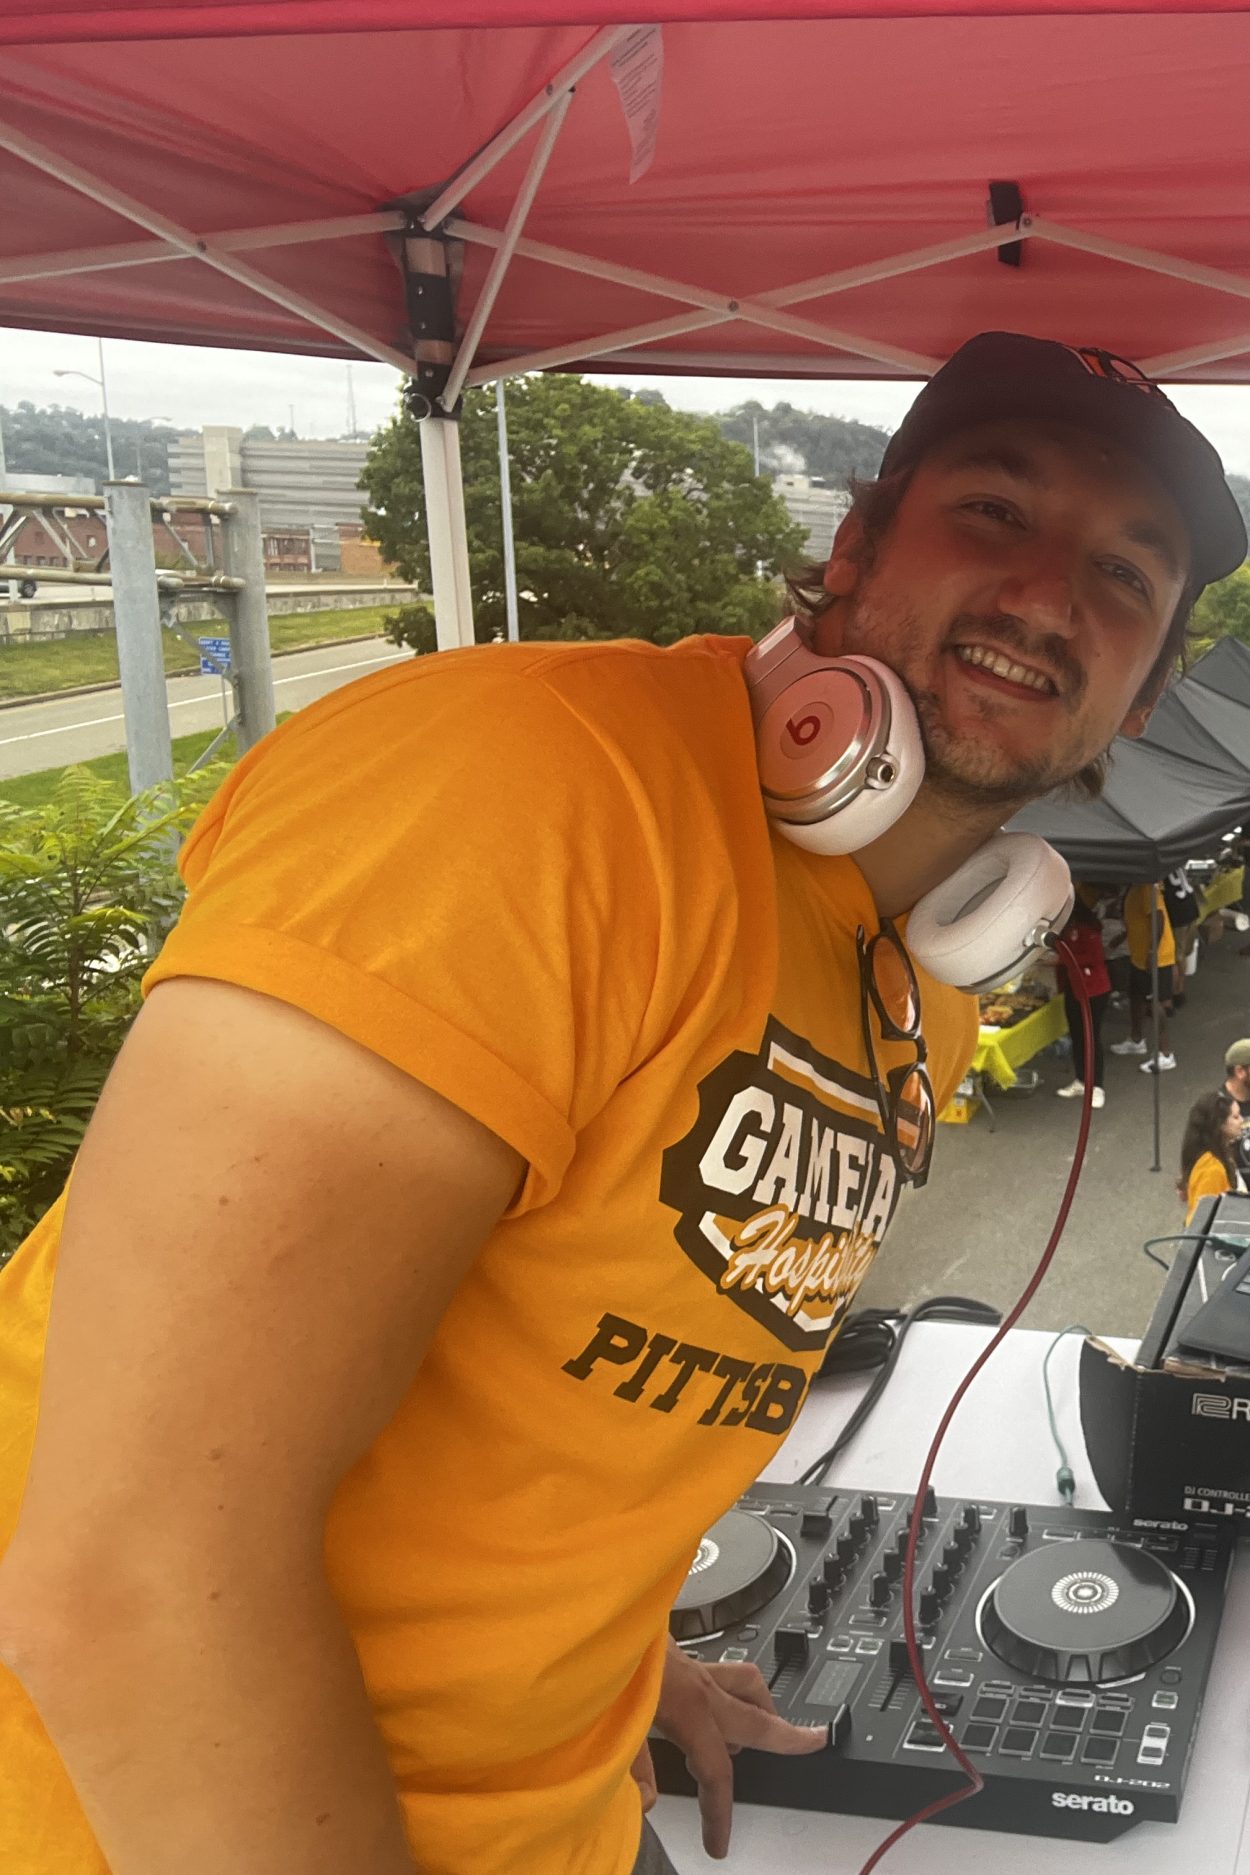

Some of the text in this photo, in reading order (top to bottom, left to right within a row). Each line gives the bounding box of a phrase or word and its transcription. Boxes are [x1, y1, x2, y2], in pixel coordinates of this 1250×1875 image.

[1184, 1485, 1196, 1495] DJ
[1132, 1518, 1189, 1531] serato
[1051, 1791, 1135, 1815] serato
